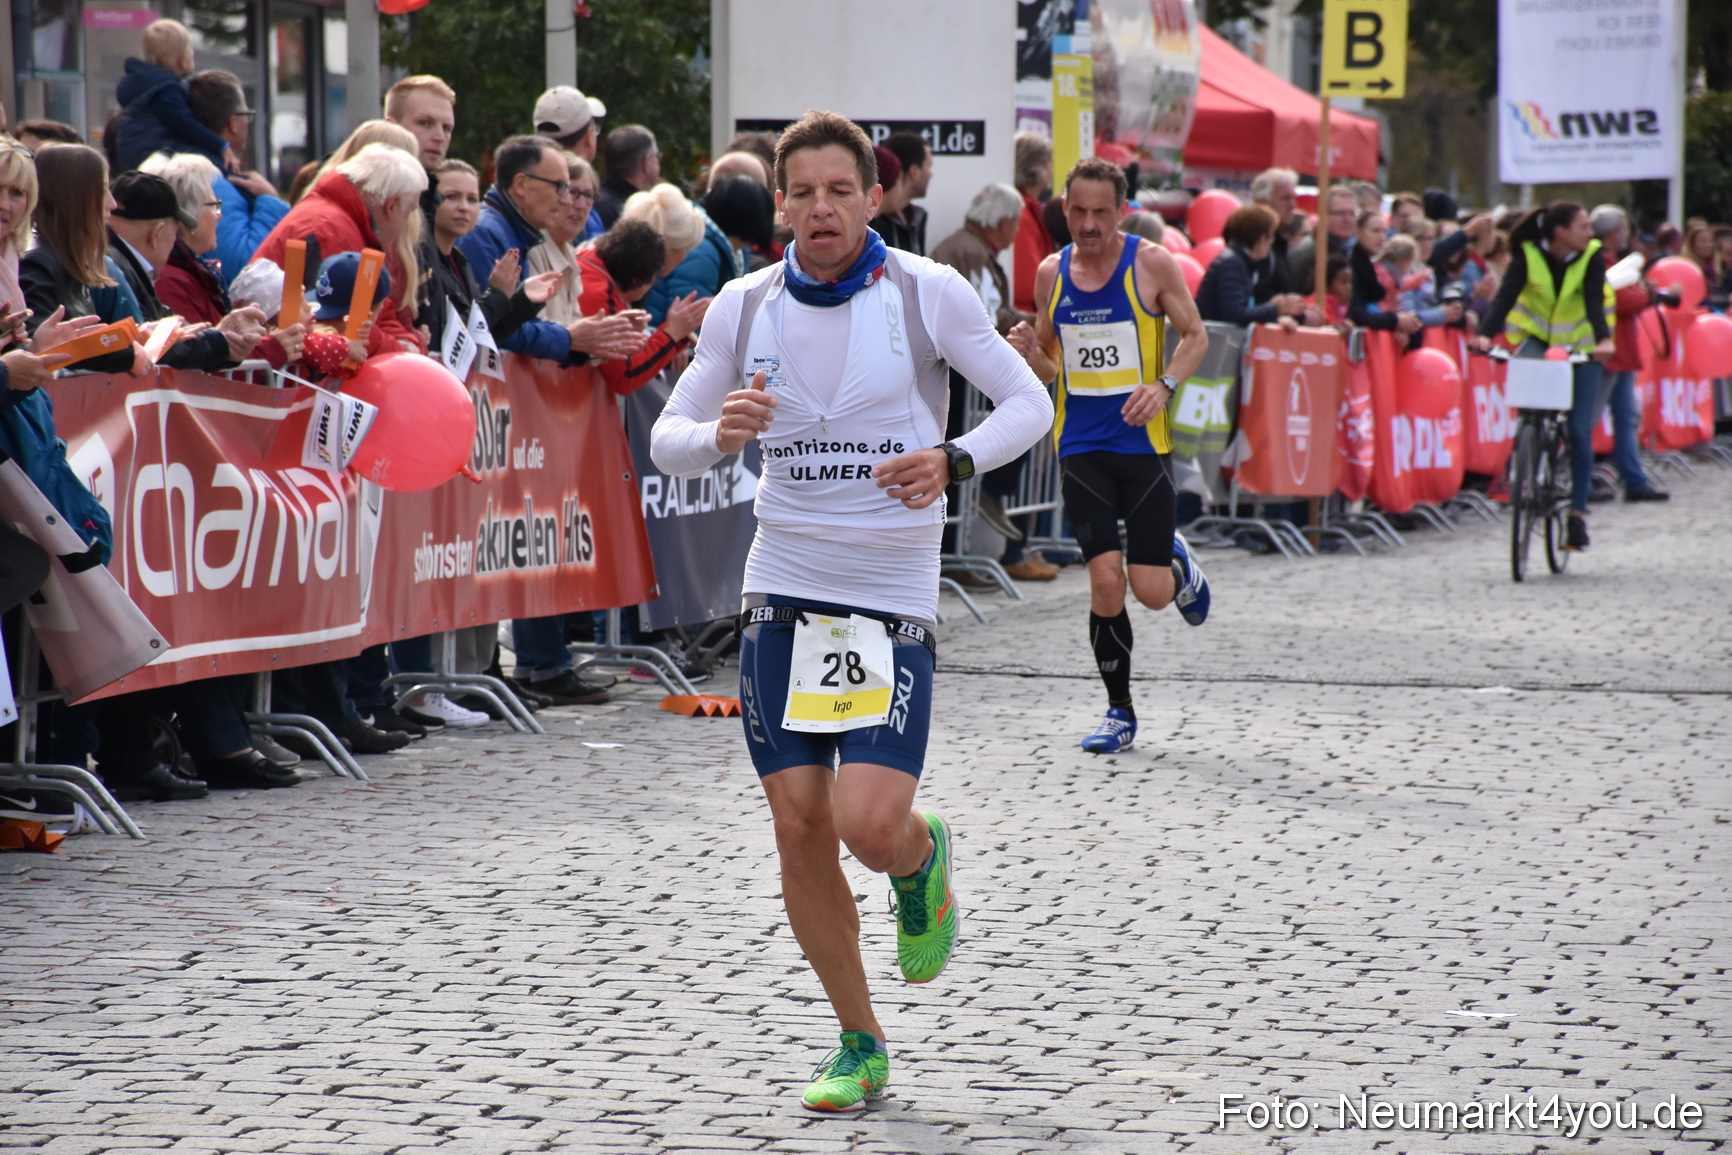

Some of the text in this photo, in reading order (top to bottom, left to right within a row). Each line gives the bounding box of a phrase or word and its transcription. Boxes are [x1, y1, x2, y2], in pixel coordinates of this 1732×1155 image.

[1345, 11, 1384, 69] B
[1078, 315, 1107, 324] LANGE
[449, 331, 466, 369] swn
[1078, 345, 1120, 368] 293
[317, 403, 331, 446] swn
[347, 401, 364, 442] swn
[790, 464, 872, 481] ULMER
[749, 606, 794, 623] ZEROD
[820, 650, 867, 687] 28
[742, 675, 766, 743] 2XU
[889, 666, 915, 735] 2XU
